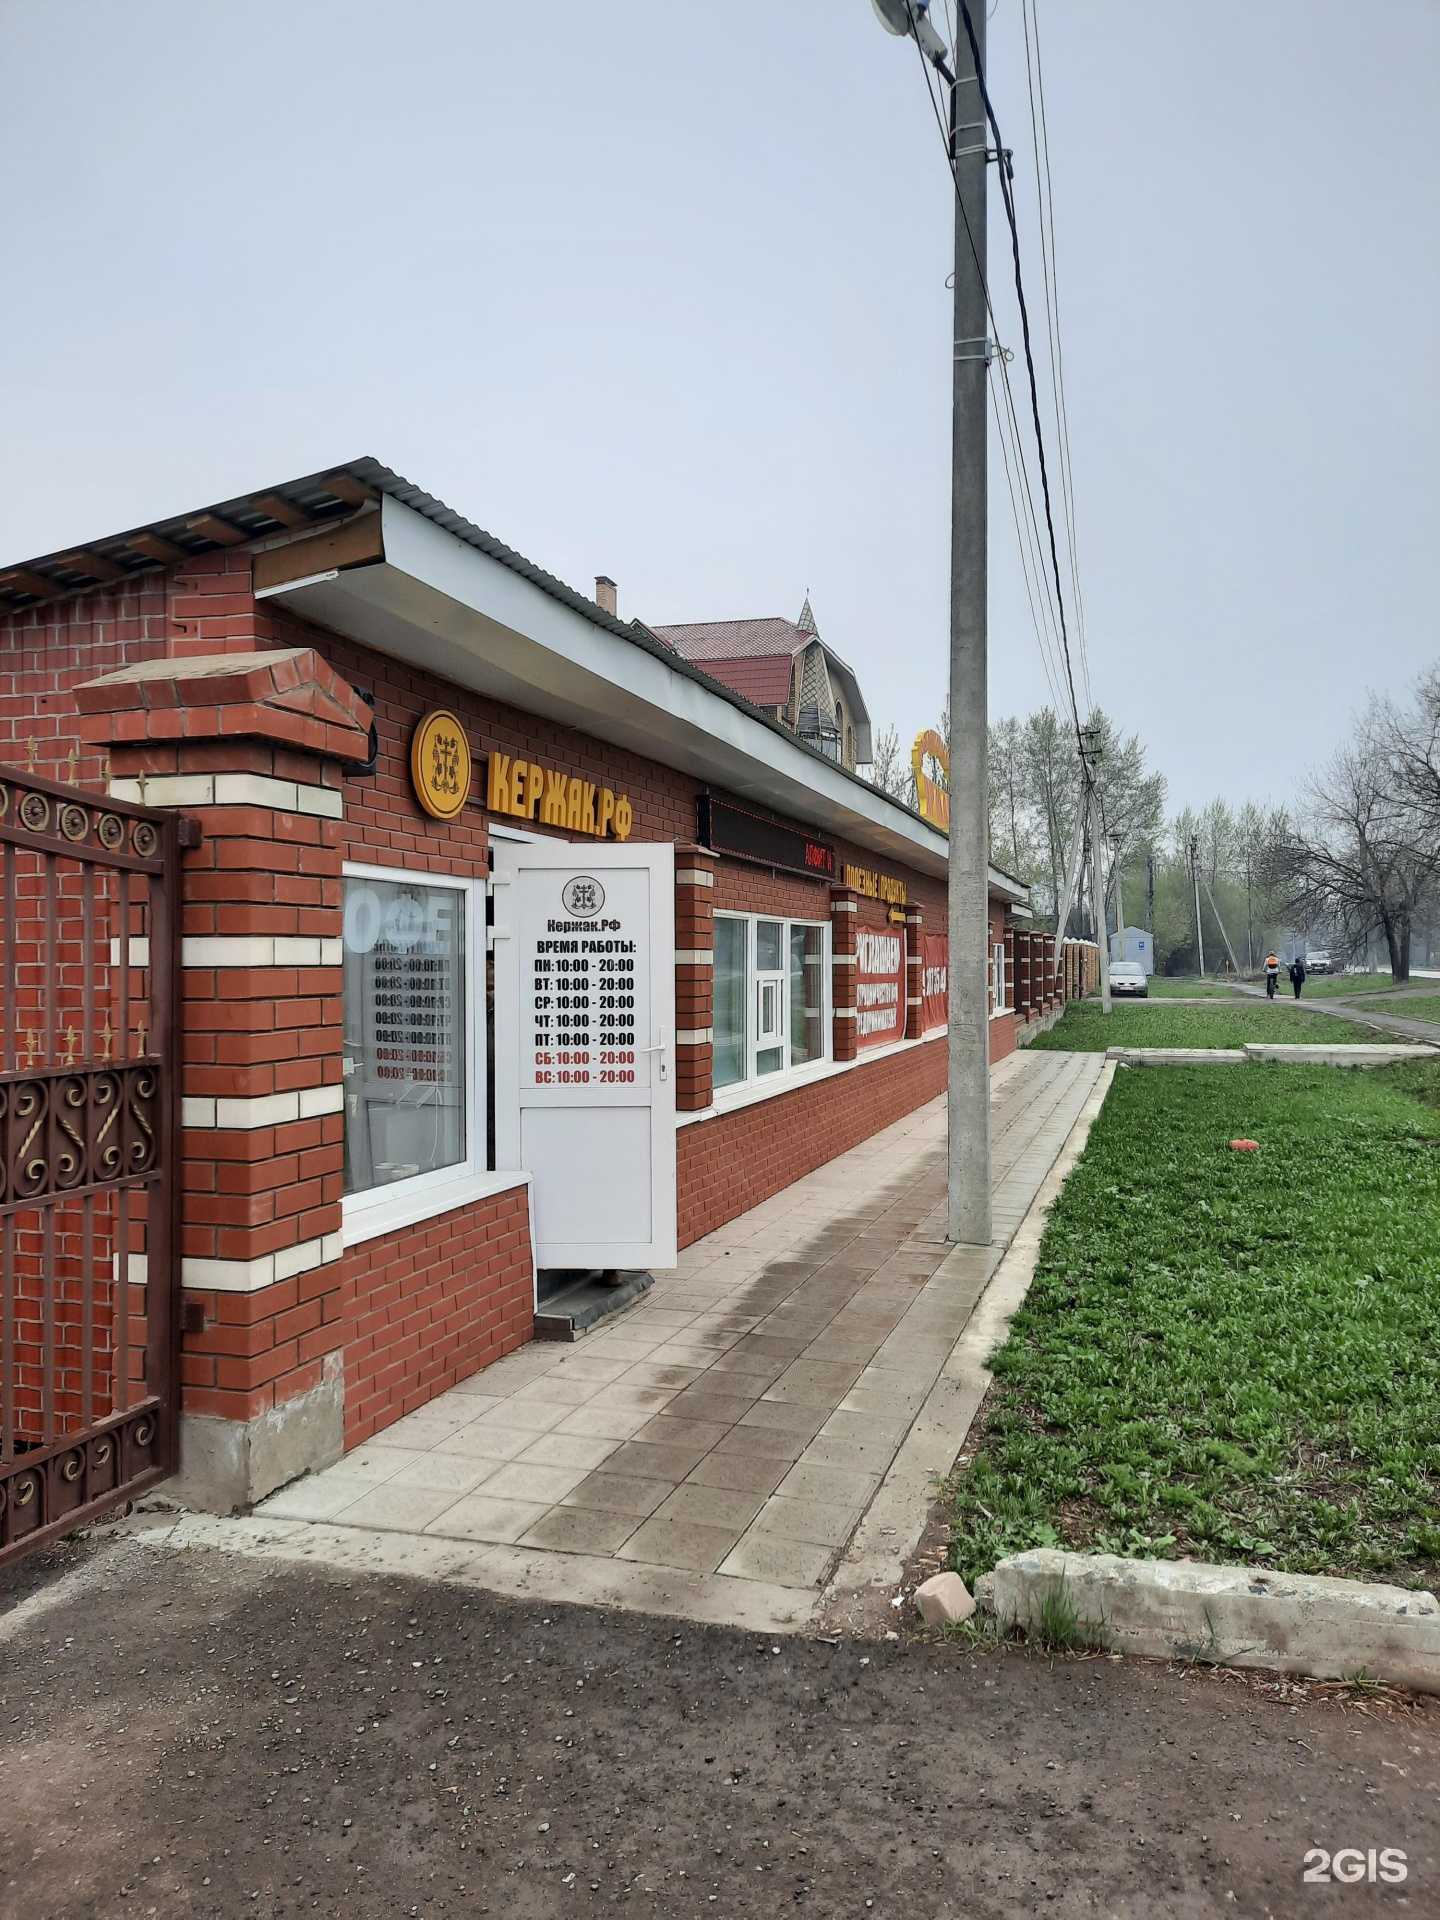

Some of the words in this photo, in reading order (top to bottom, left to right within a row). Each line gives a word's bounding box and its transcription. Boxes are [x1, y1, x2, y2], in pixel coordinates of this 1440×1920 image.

[487, 751, 632, 841] КЕРЖАК.РФ
[344, 888, 451, 954] ОФЕ
[547, 919, 621, 933] Кержак.РФ
[536, 940, 579, 954] ВРЕМЯ
[581, 940, 637, 953] РАБОТЫ:
[599, 958, 634, 973] 20:00
[556, 977, 589, 991] 10:00
[599, 977, 634, 991] 20:00
[556, 996, 589, 1009] 10:00
[599, 996, 634, 1009] 20:00
[556, 1014, 589, 1027] 10:00
[599, 1014, 634, 1027] 20:00
[556, 1033, 589, 1046] 10:00
[599, 1033, 634, 1046] 20:00
[599, 1052, 634, 1065] 20:00
[599, 1070, 634, 1084] 20:00
